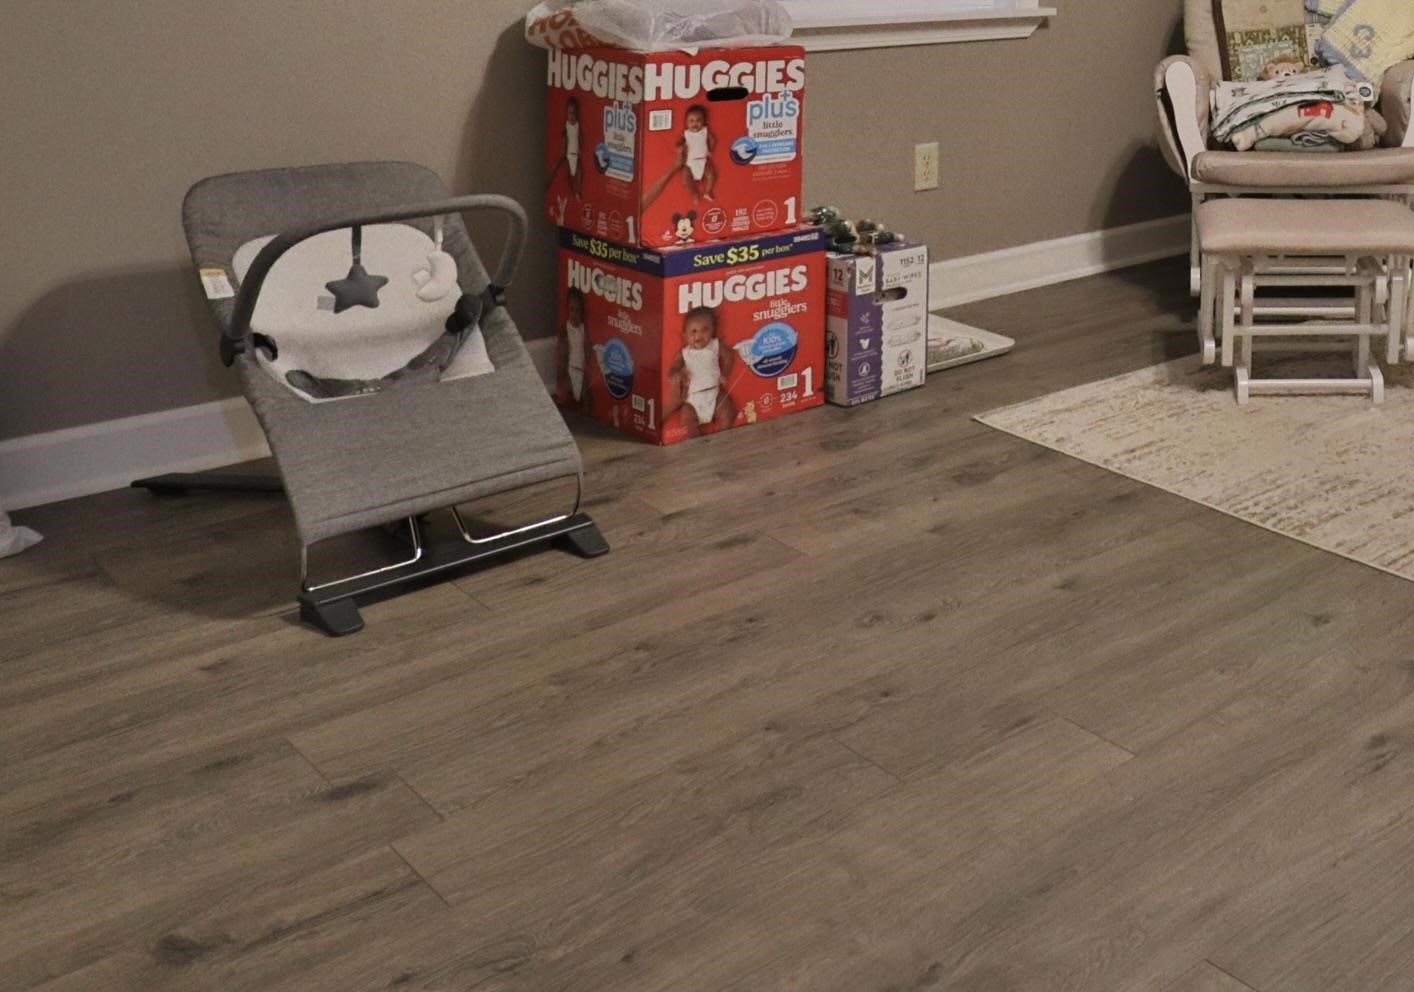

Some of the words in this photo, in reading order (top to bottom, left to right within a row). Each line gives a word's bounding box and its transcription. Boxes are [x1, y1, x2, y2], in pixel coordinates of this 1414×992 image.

[547, 49, 643, 105] HUGGIES
[644, 59, 805, 101] HUGGIES
[606, 104, 634, 133] plus
[750, 96, 798, 126] plus
[762, 120, 784, 130] little
[753, 128, 793, 139] snugglers
[784, 196, 797, 225] 1
[626, 216, 636, 244] 1
[572, 234, 590, 248] Save
[590, 238, 608, 259] $35
[608, 248, 621, 261] per
[693, 254, 725, 267] Save
[726, 244, 760, 265] $35
[761, 248, 775, 257] per
[568, 258, 643, 311] HUGGIES
[833, 268, 844, 281] 12
[678, 265, 808, 315] HUGGIES
[753, 302, 808, 321] snugglers
[801, 366, 814, 398] 1
[780, 391, 798, 404] 234
[647, 398, 656, 431] 1
